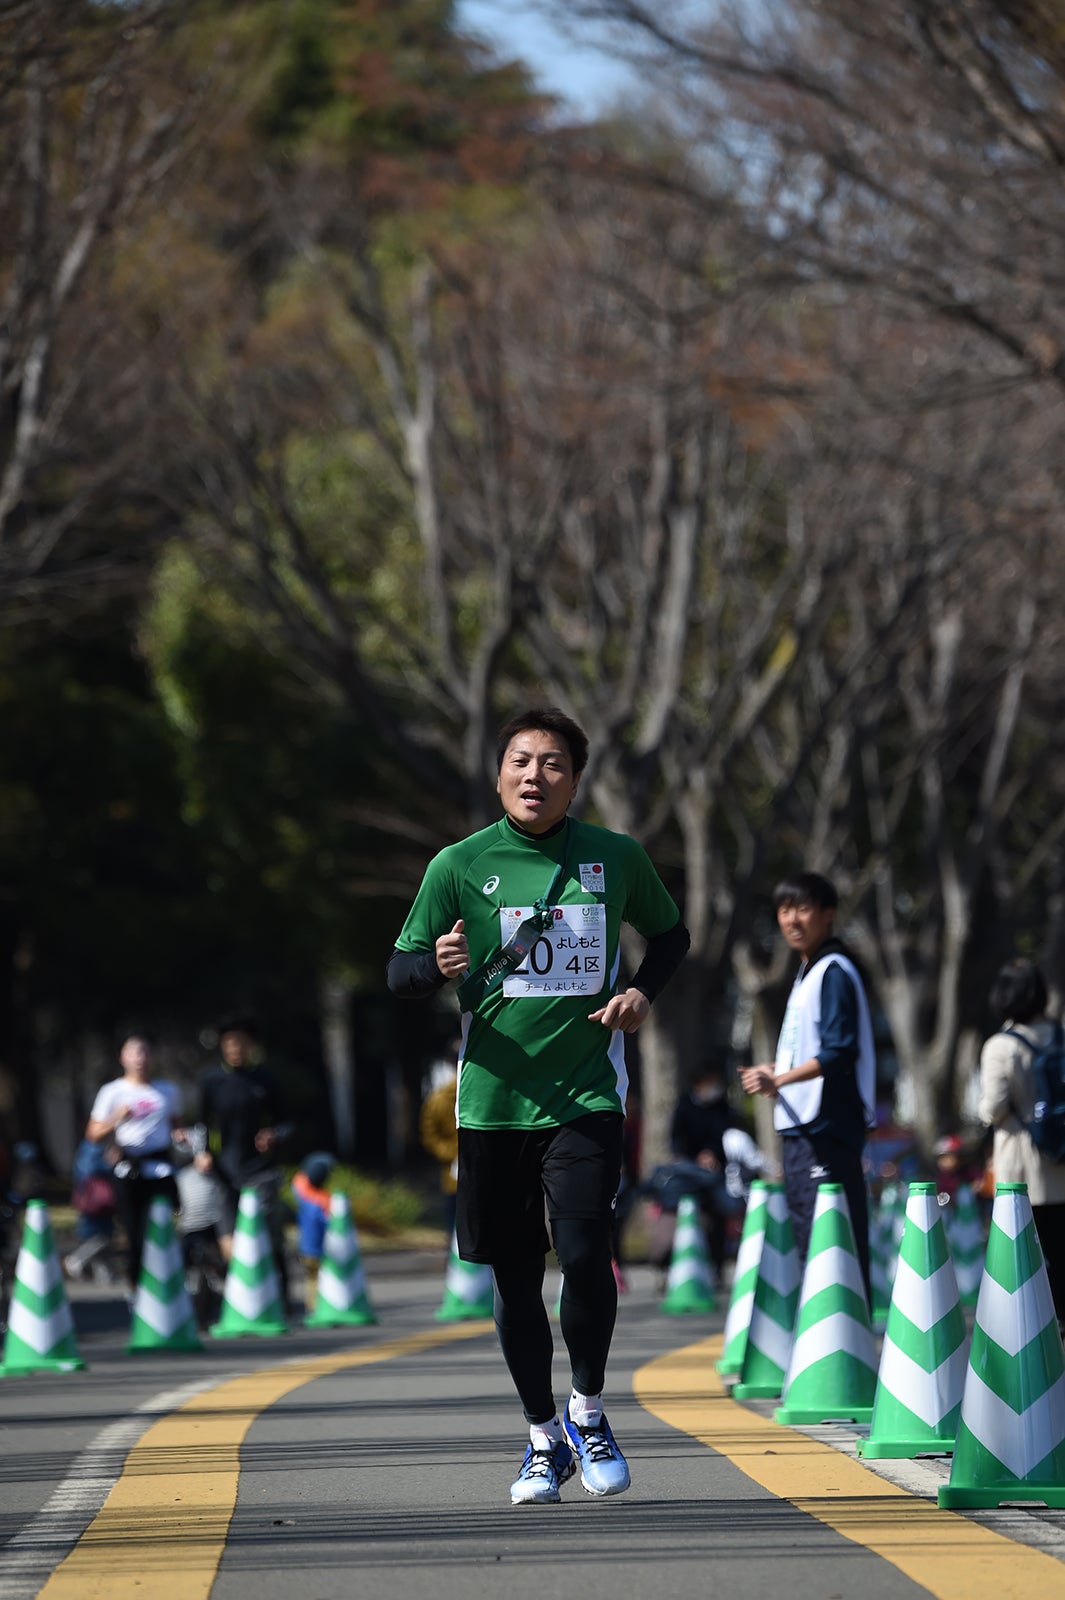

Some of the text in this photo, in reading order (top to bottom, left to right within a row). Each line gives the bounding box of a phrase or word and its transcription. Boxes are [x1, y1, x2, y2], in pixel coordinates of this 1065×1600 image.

[556, 936, 600, 949] よしもと
[511, 937, 554, 976] 0
[565, 955, 600, 974] 4区
[525, 981, 588, 992] チーム よしもと
